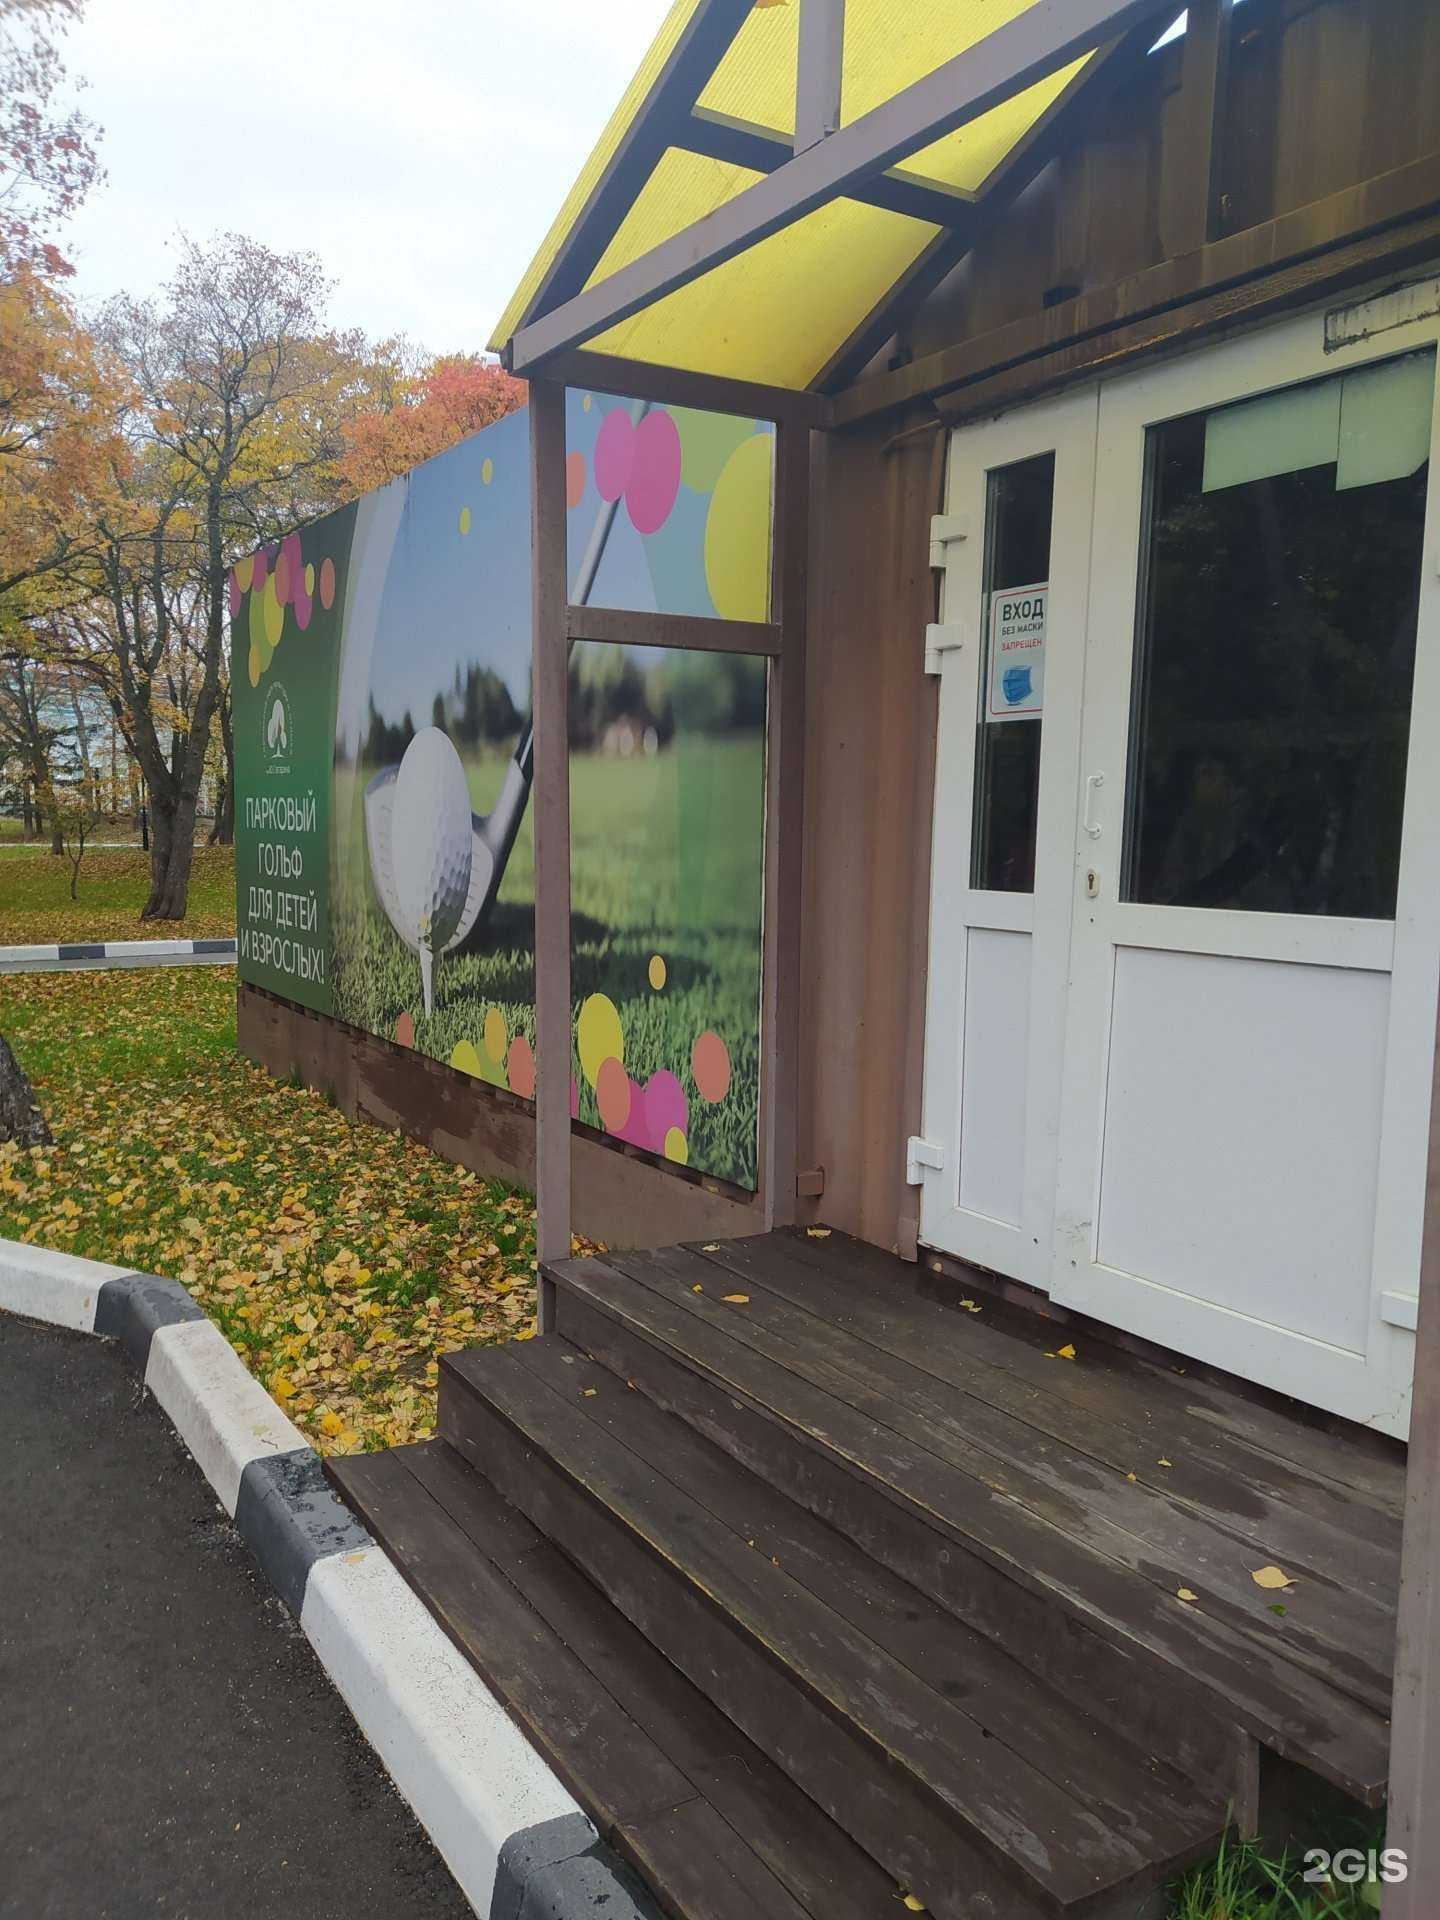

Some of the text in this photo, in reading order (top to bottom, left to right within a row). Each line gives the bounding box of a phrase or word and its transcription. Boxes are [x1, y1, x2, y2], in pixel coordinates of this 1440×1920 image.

[1001, 622, 1043, 636] БЕЗ МАСКИ
[1003, 598, 1043, 621] ВХОД
[245, 789, 316, 833] ПАРКОВЫЙ
[258, 842, 303, 880] ГОЛЬФ
[247, 886, 318, 933] ДЛЯ ДЕТЕЙ
[240, 927, 325, 984] И ВЗРОСЛЫХ!
